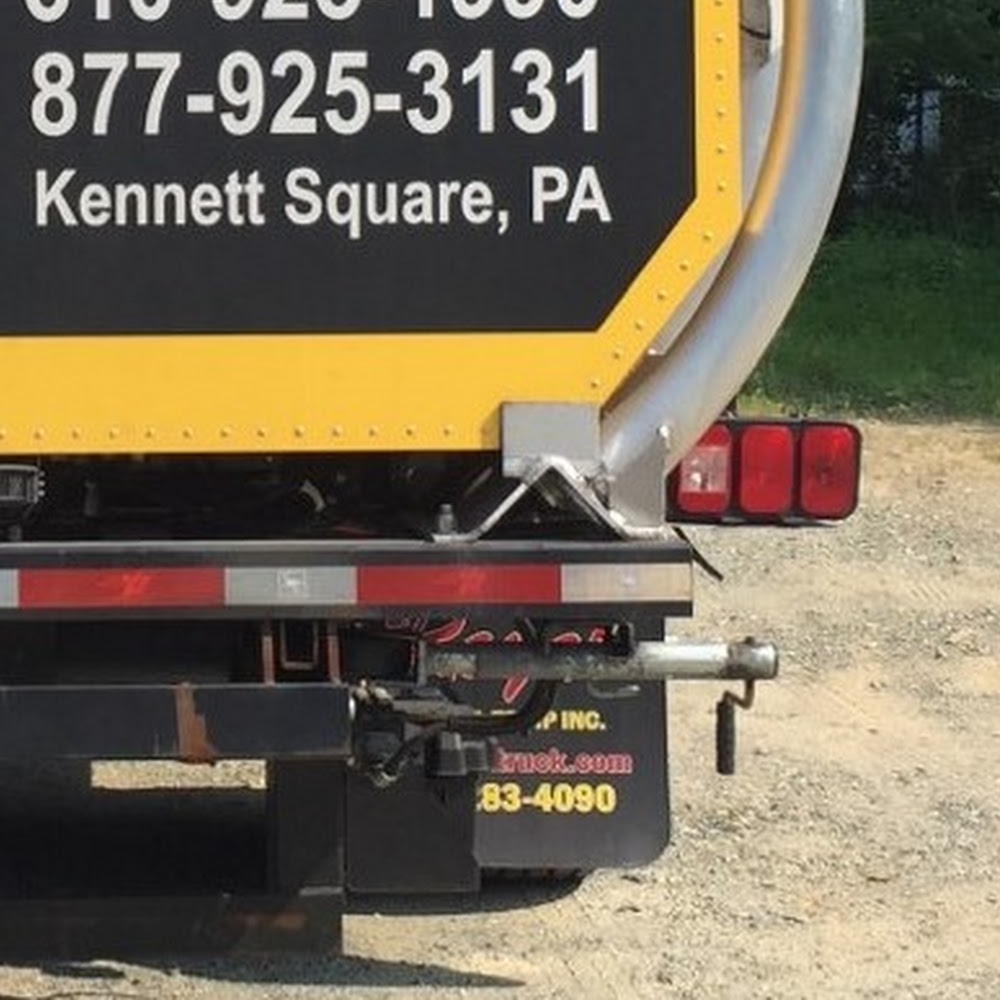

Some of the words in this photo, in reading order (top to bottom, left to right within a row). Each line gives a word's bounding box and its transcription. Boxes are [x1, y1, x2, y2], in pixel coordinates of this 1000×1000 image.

[30, 48, 598, 136] 877-925-3131
[35, 168, 265, 227] Kennett
[284, 166, 508, 239] Square,
[532, 165, 612, 224] PA
[562, 710, 606, 730] INC.
